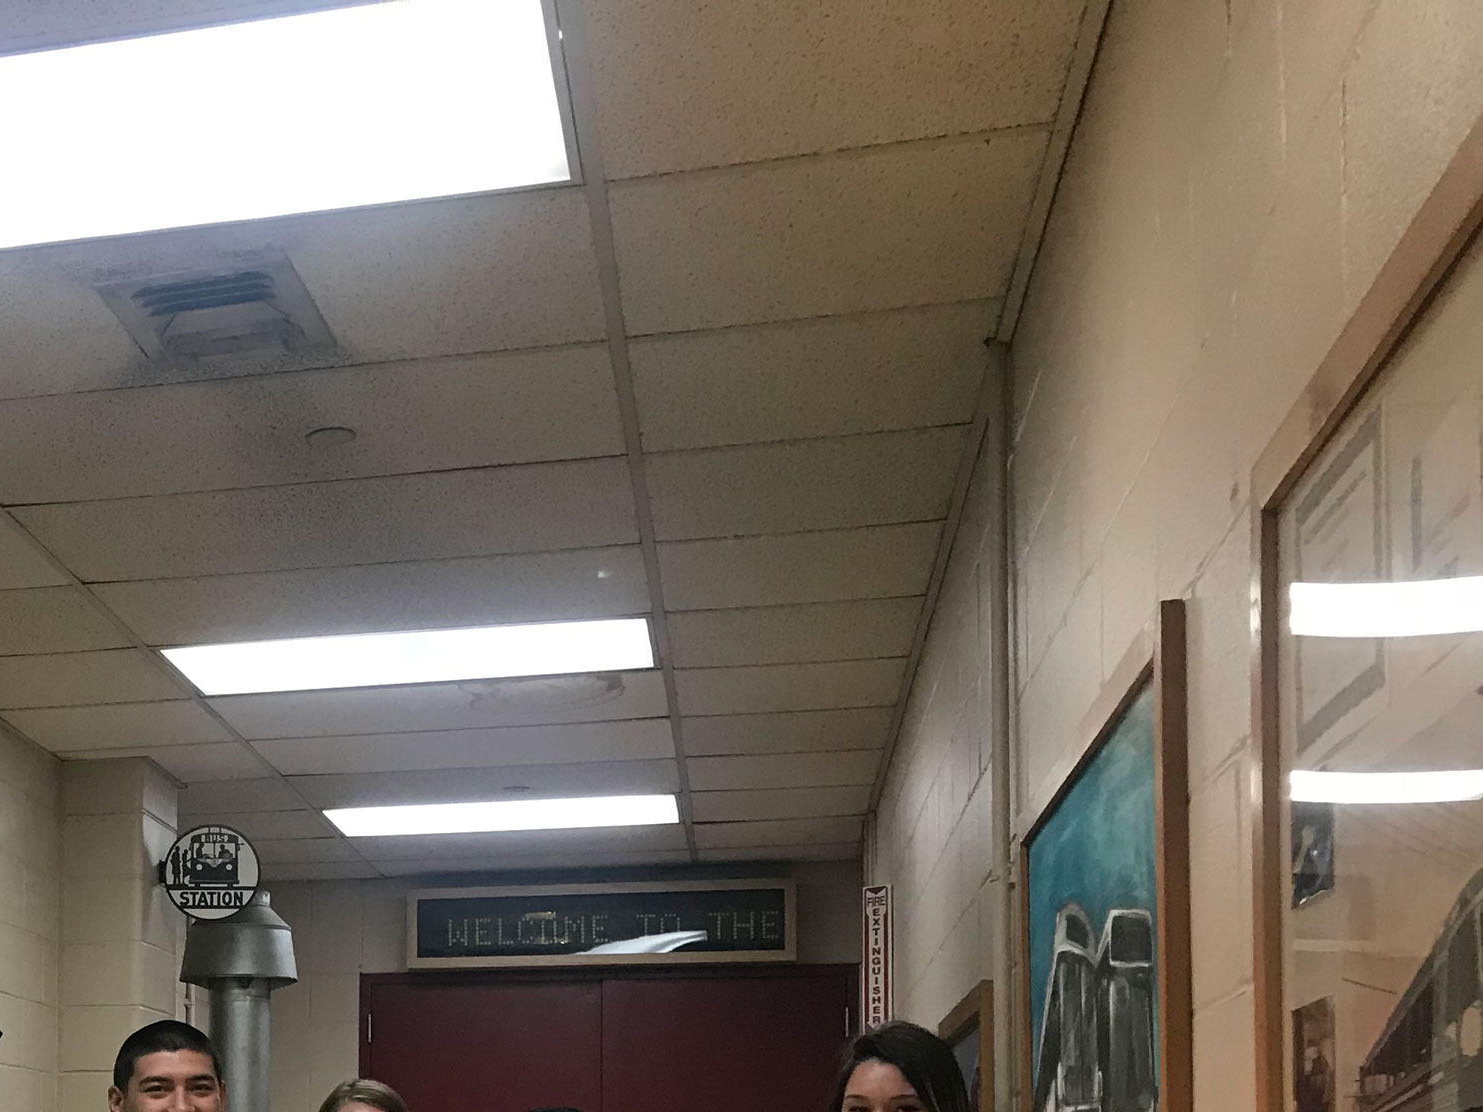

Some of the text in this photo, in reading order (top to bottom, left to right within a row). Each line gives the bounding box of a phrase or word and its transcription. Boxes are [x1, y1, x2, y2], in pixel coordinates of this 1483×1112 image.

[200, 834, 229, 843] BUS
[179, 891, 243, 907] STATION
[868, 895, 885, 907] FIRE
[448, 914, 609, 946] WELCOME
[709, 911, 780, 940] THE
[872, 908, 881, 1024] EXTINGUISHER
